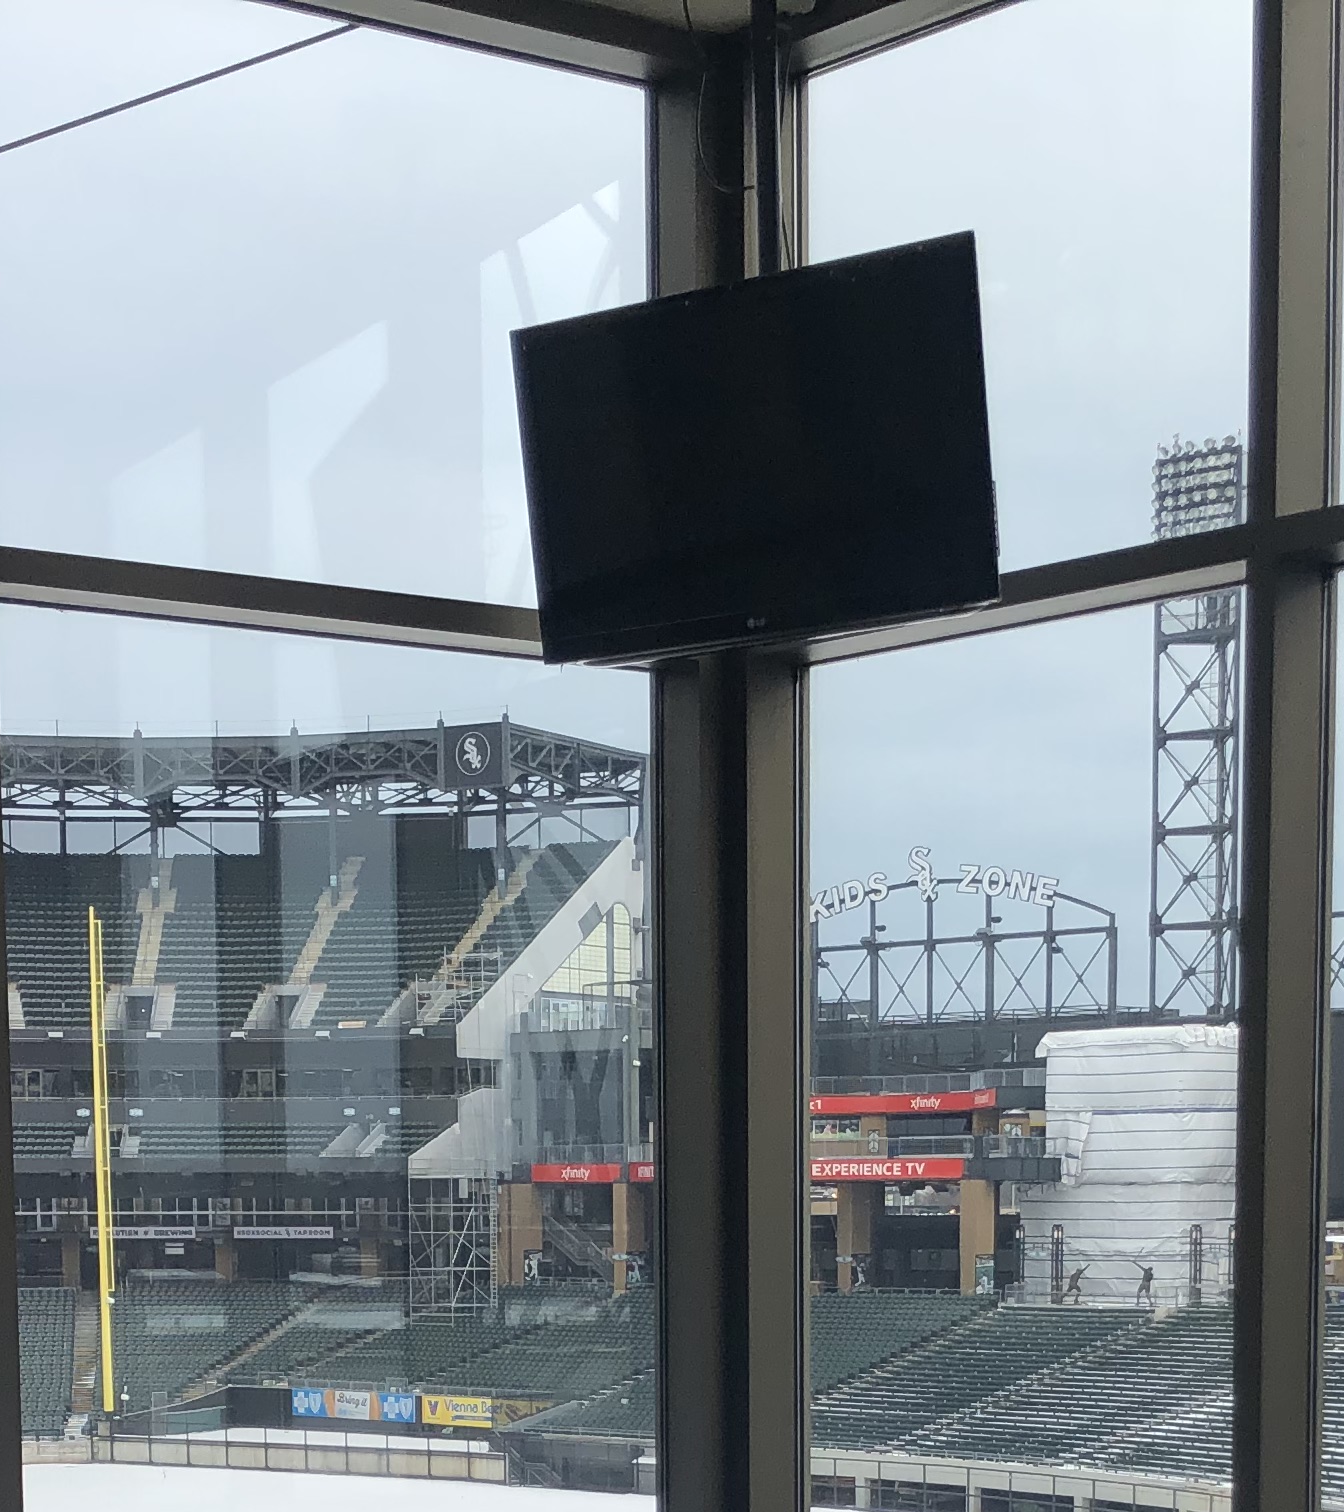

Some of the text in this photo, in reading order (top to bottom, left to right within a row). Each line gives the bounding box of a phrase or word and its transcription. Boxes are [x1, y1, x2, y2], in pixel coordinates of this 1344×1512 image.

[810, 871, 890, 922] KIDS
[956, 863, 1060, 908] ZONE
[910, 1096, 941, 1110] xfinity
[561, 1166, 590, 1180] xfinity
[811, 1162, 926, 1176] EXPERIENCE TV
[443, 1399, 479, 1414] Vienna
